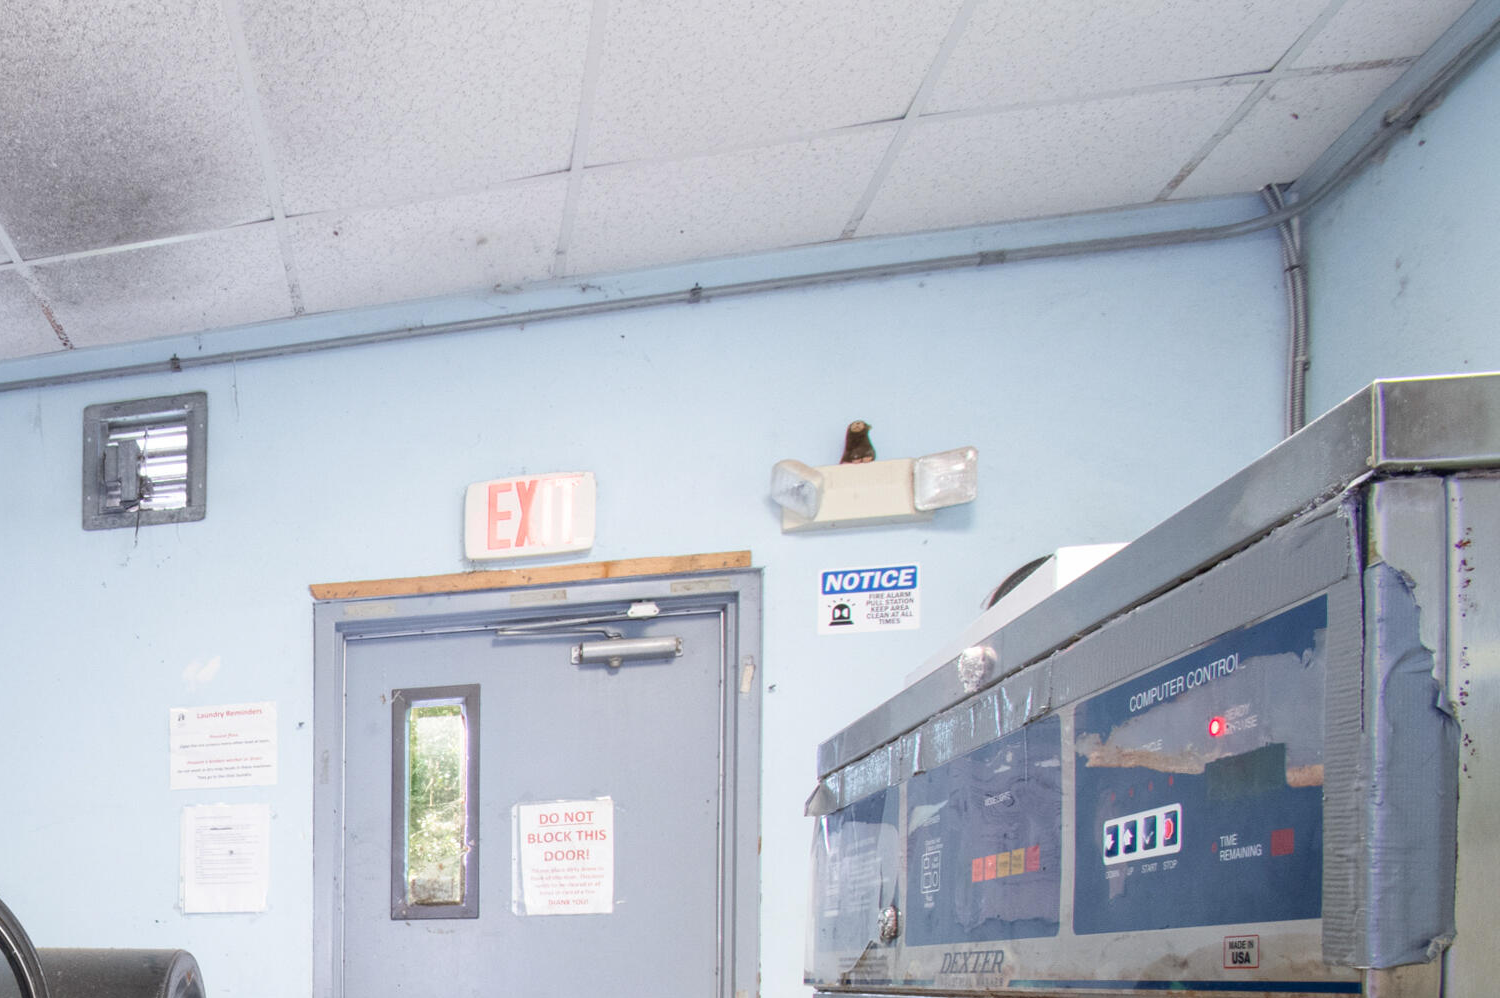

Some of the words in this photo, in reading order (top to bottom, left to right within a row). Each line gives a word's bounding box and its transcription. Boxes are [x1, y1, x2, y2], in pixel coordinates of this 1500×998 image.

[487, 478, 582, 550] EXIT
[825, 568, 916, 592] NOTICE
[866, 611, 889, 619] CLEAN
[1129, 676, 1185, 713] COMPUTER
[1186, 653, 1247, 689] CONTROL
[196, 711, 225, 720] Laundry
[226, 708, 263, 718] Reminders
[540, 813, 559, 825] DO
[564, 811, 595, 823] NOT
[527, 831, 573, 844] BLOCK
[576, 829, 607, 841] THIS
[1220, 833, 1238, 846] TIME
[544, 848, 590, 862] DOOR!
[1220, 844, 1263, 861] REMAINING
[1229, 939, 1247, 950] MADE
[1248, 938, 1254, 949] IN
[940, 950, 1005, 974] DEXTER
[1231, 950, 1251, 965] USA
